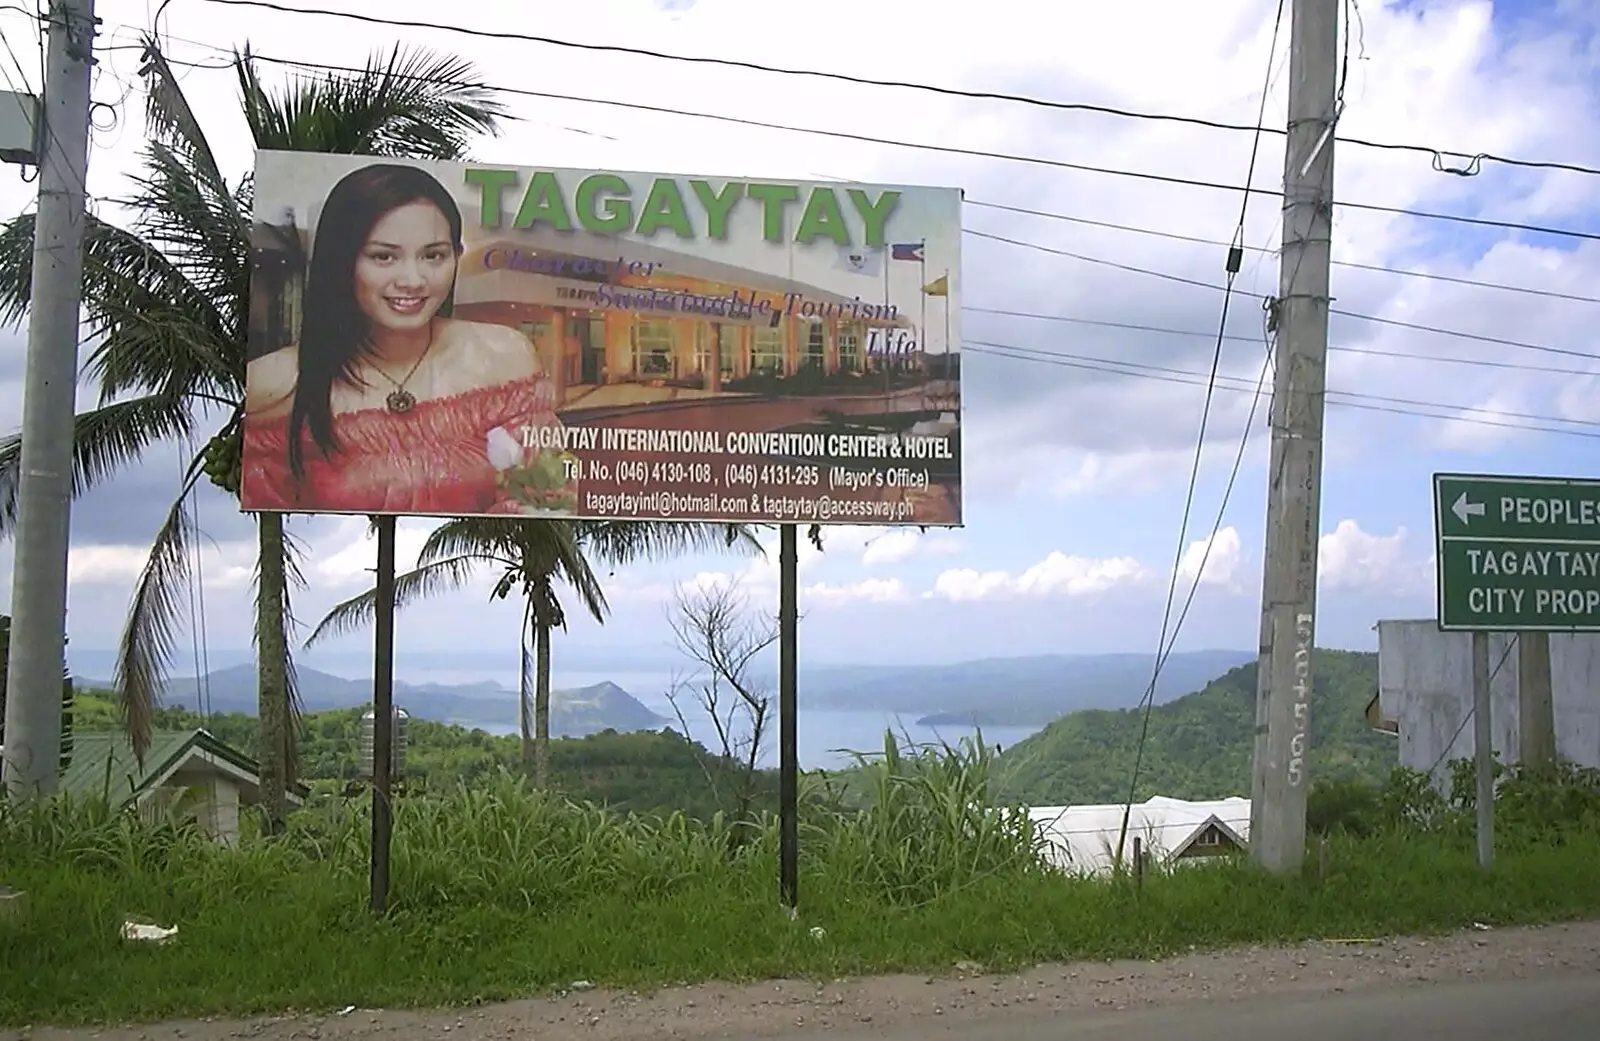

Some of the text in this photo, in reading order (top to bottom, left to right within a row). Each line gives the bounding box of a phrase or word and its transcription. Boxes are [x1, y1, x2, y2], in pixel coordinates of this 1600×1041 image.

[465, 168, 902, 247] TAGAYTAY
[483, 248, 663, 277] Character
[782, 292, 898, 321] Tourism
[867, 328, 917, 358] Life
[520, 425, 953, 459] TAGAYTAY INTERNATIONAL CONVENTION CENTER & HOTEL
[563, 459, 587, 480] Tel.
[590, 461, 613, 480] No.
[615, 461, 649, 487] (046)
[725, 463, 758, 489] (046)
[760, 466, 819, 486] 4131-295
[829, 466, 883, 492] (Mayor's
[886, 467, 929, 492] Office)
[586, 490, 914, 520] tagaytayintl@hotmail.com & tagtaytay@accessway.ph
[1500, 496, 1600, 525] PEOPLE
[1466, 550, 1600, 577] TAGAYTAY
[1468, 587, 1600, 614] CITY PROP
